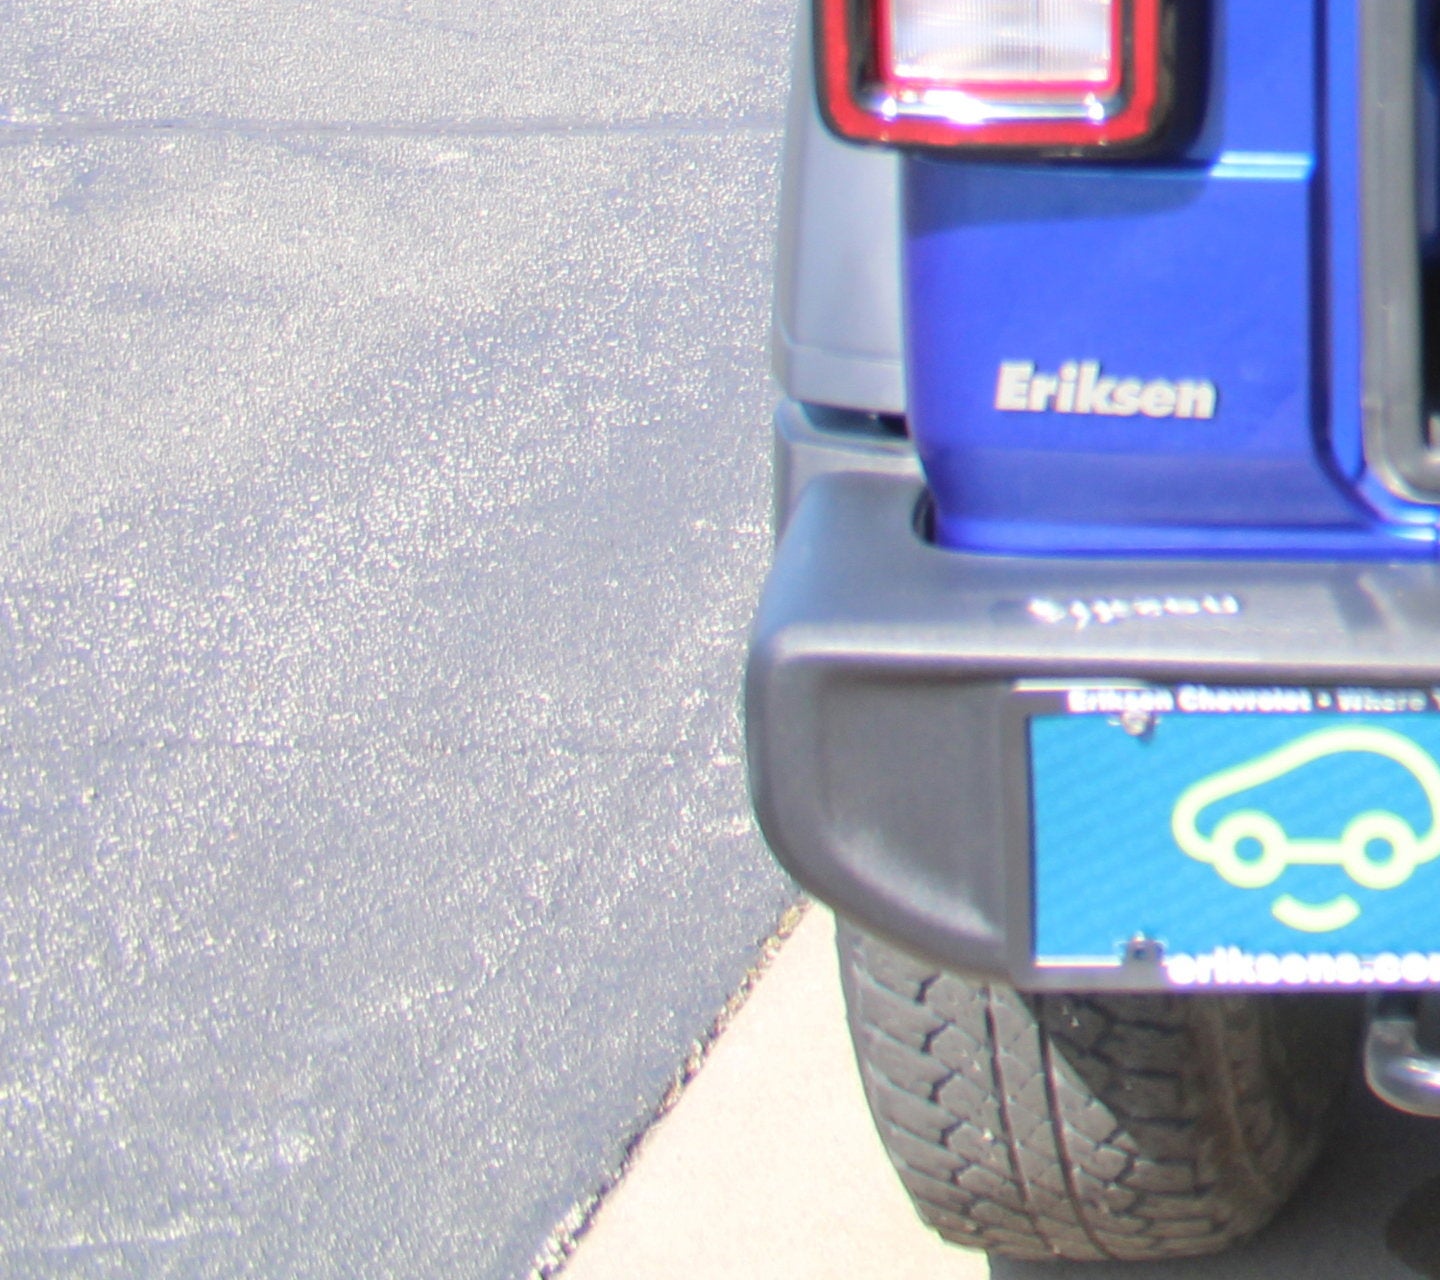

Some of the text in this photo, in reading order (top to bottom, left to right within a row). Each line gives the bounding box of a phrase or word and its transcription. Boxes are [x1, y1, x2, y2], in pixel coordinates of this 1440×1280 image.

[995, 358, 1216, 419] Eriksen
[1178, 684, 1312, 713] Chevrolet
[1336, 686, 1427, 712] Where
